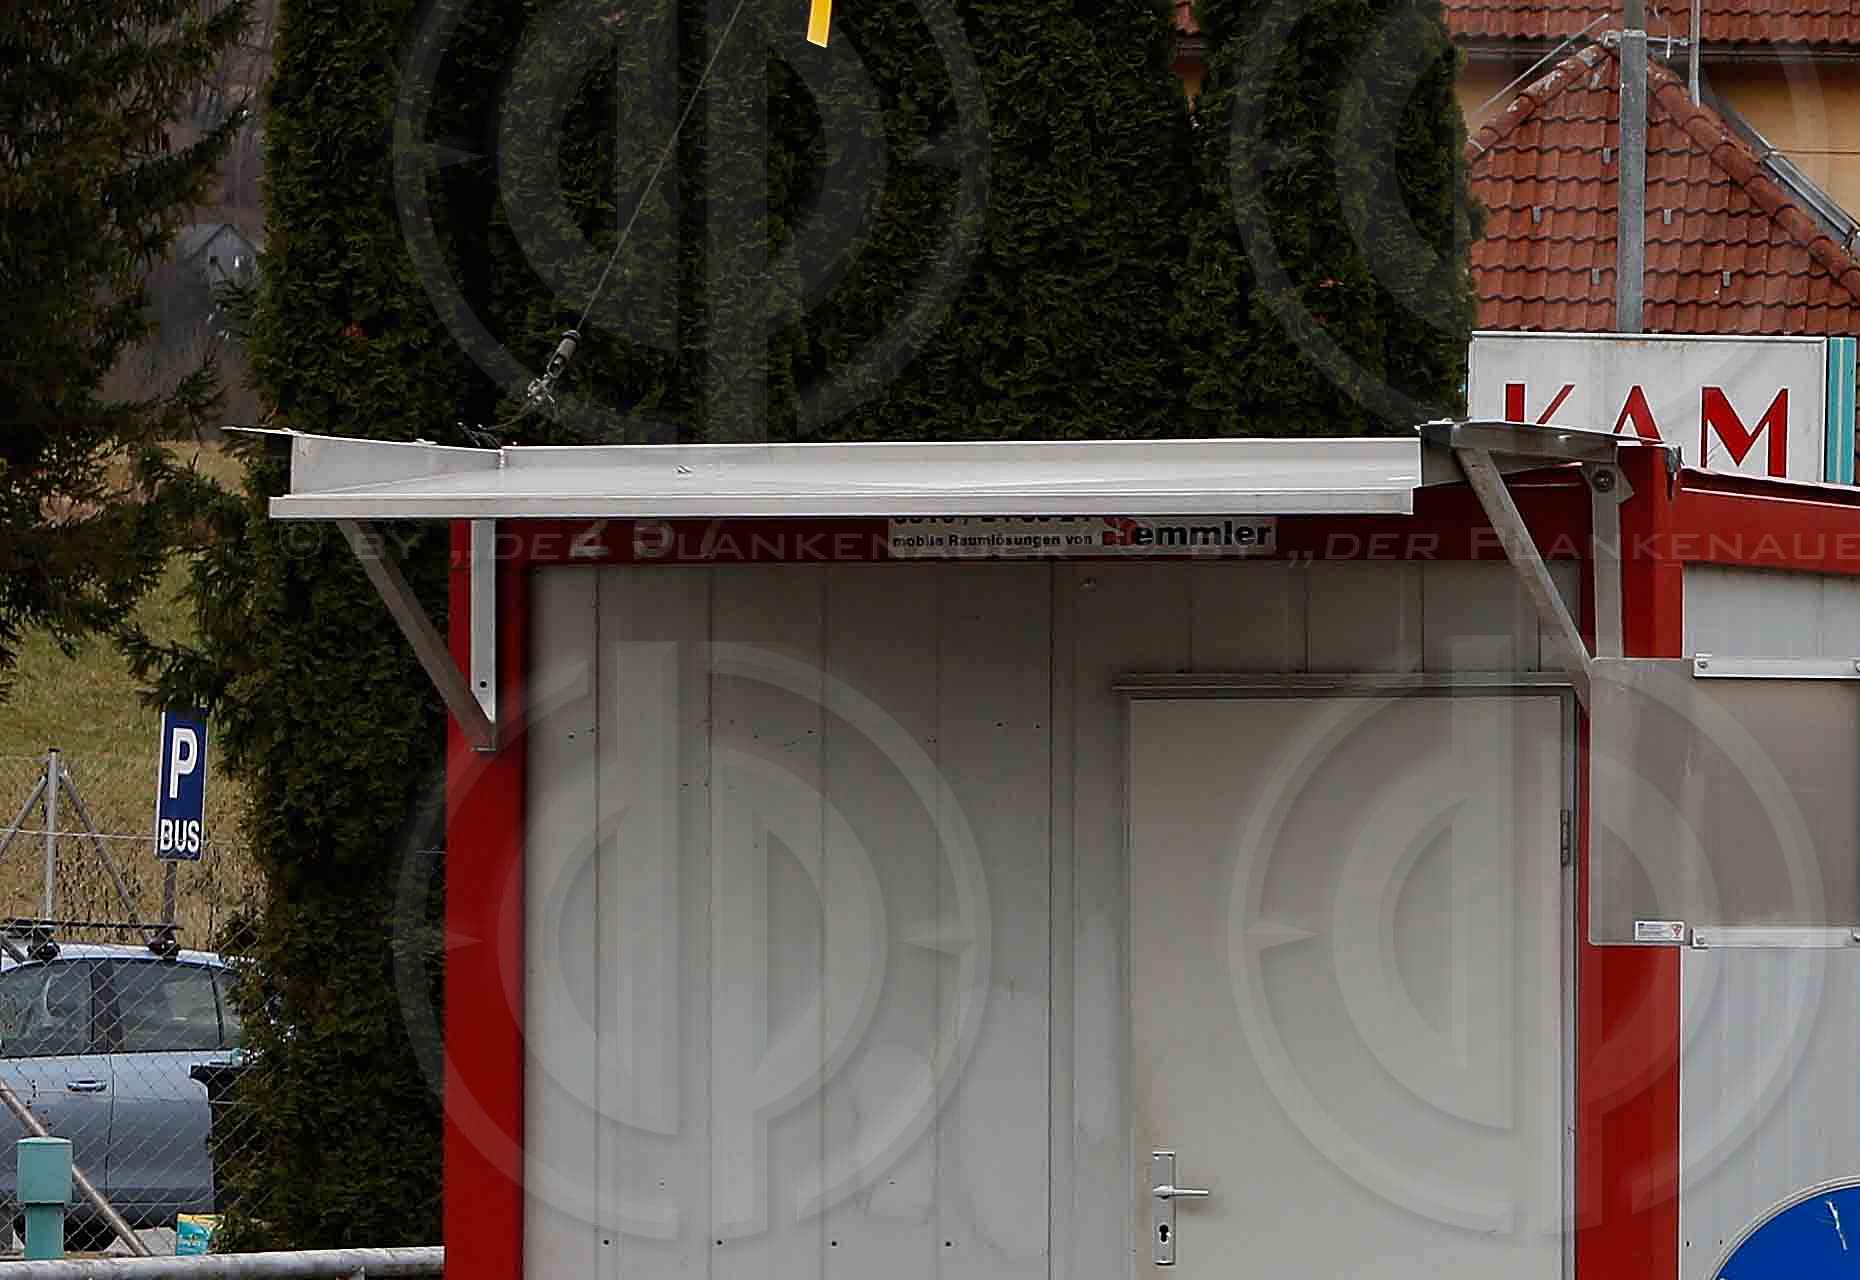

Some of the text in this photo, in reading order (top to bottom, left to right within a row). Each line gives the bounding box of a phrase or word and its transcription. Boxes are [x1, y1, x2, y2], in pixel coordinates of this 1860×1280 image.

[1065, 537, 1093, 546] von
[169, 727, 198, 799] P
[160, 818, 201, 853] BUS
